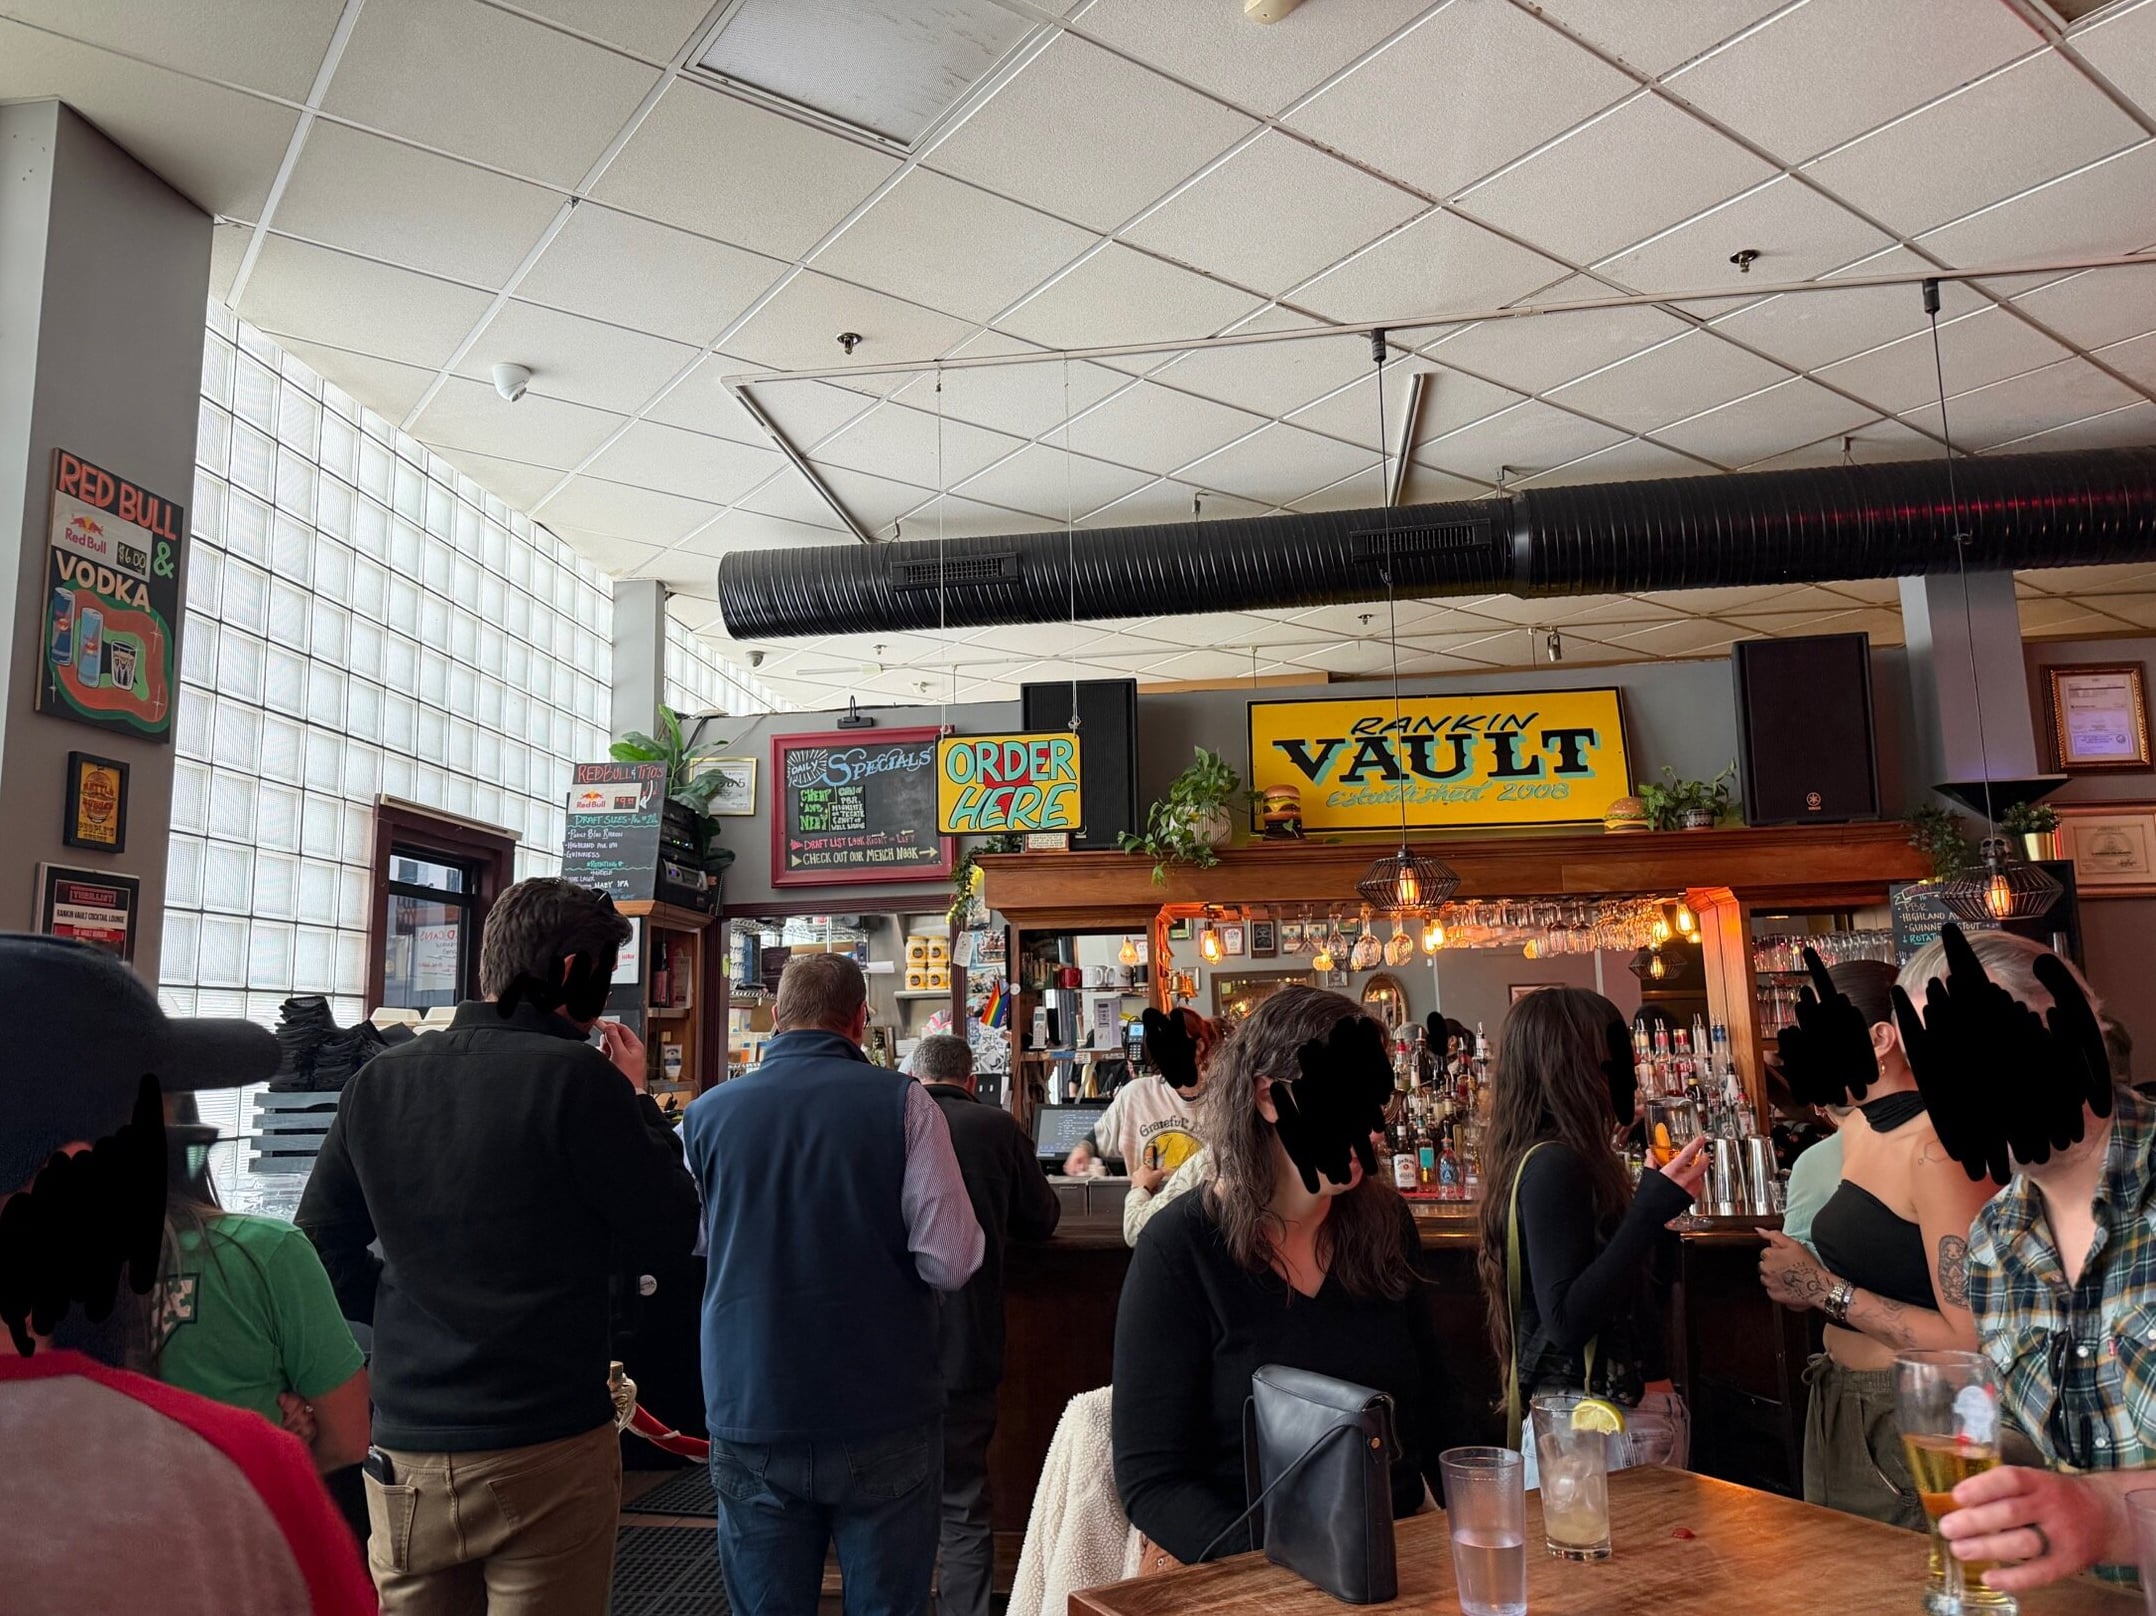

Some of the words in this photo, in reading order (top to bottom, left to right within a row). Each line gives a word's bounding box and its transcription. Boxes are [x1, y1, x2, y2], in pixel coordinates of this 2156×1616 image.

[59, 453, 115, 508] RED
[119, 482, 177, 541] BULL
[65, 527, 86, 547] Red
[87, 535, 107, 554] Bull
[153, 541, 174, 579] &
[55, 550, 151, 613] VODKA
[1351, 712, 1539, 736] RANKIN
[791, 759, 818, 776] DAILY
[822, 746, 935, 787] SPECIALS
[946, 739, 1077, 784] ORDER
[1272, 728, 1600, 786] VAULT
[948, 782, 1078, 830] HERE
[1326, 780, 1492, 808] Established
[1497, 782, 1569, 802] 2008
[802, 852, 832, 865] CHECK
[833, 851, 848, 863] OUT
[850, 850, 865, 862] OUR
[866, 848, 894, 862] MERCH
[896, 846, 919, 860] NOOK
[804, 839, 828, 850] DRAFT
[830, 837, 847, 848] LIST
[1902, 912, 1946, 923] HIGHLAND
[1905, 903, 1928, 912] PBR
[1909, 922, 1946, 933] GUINNE
